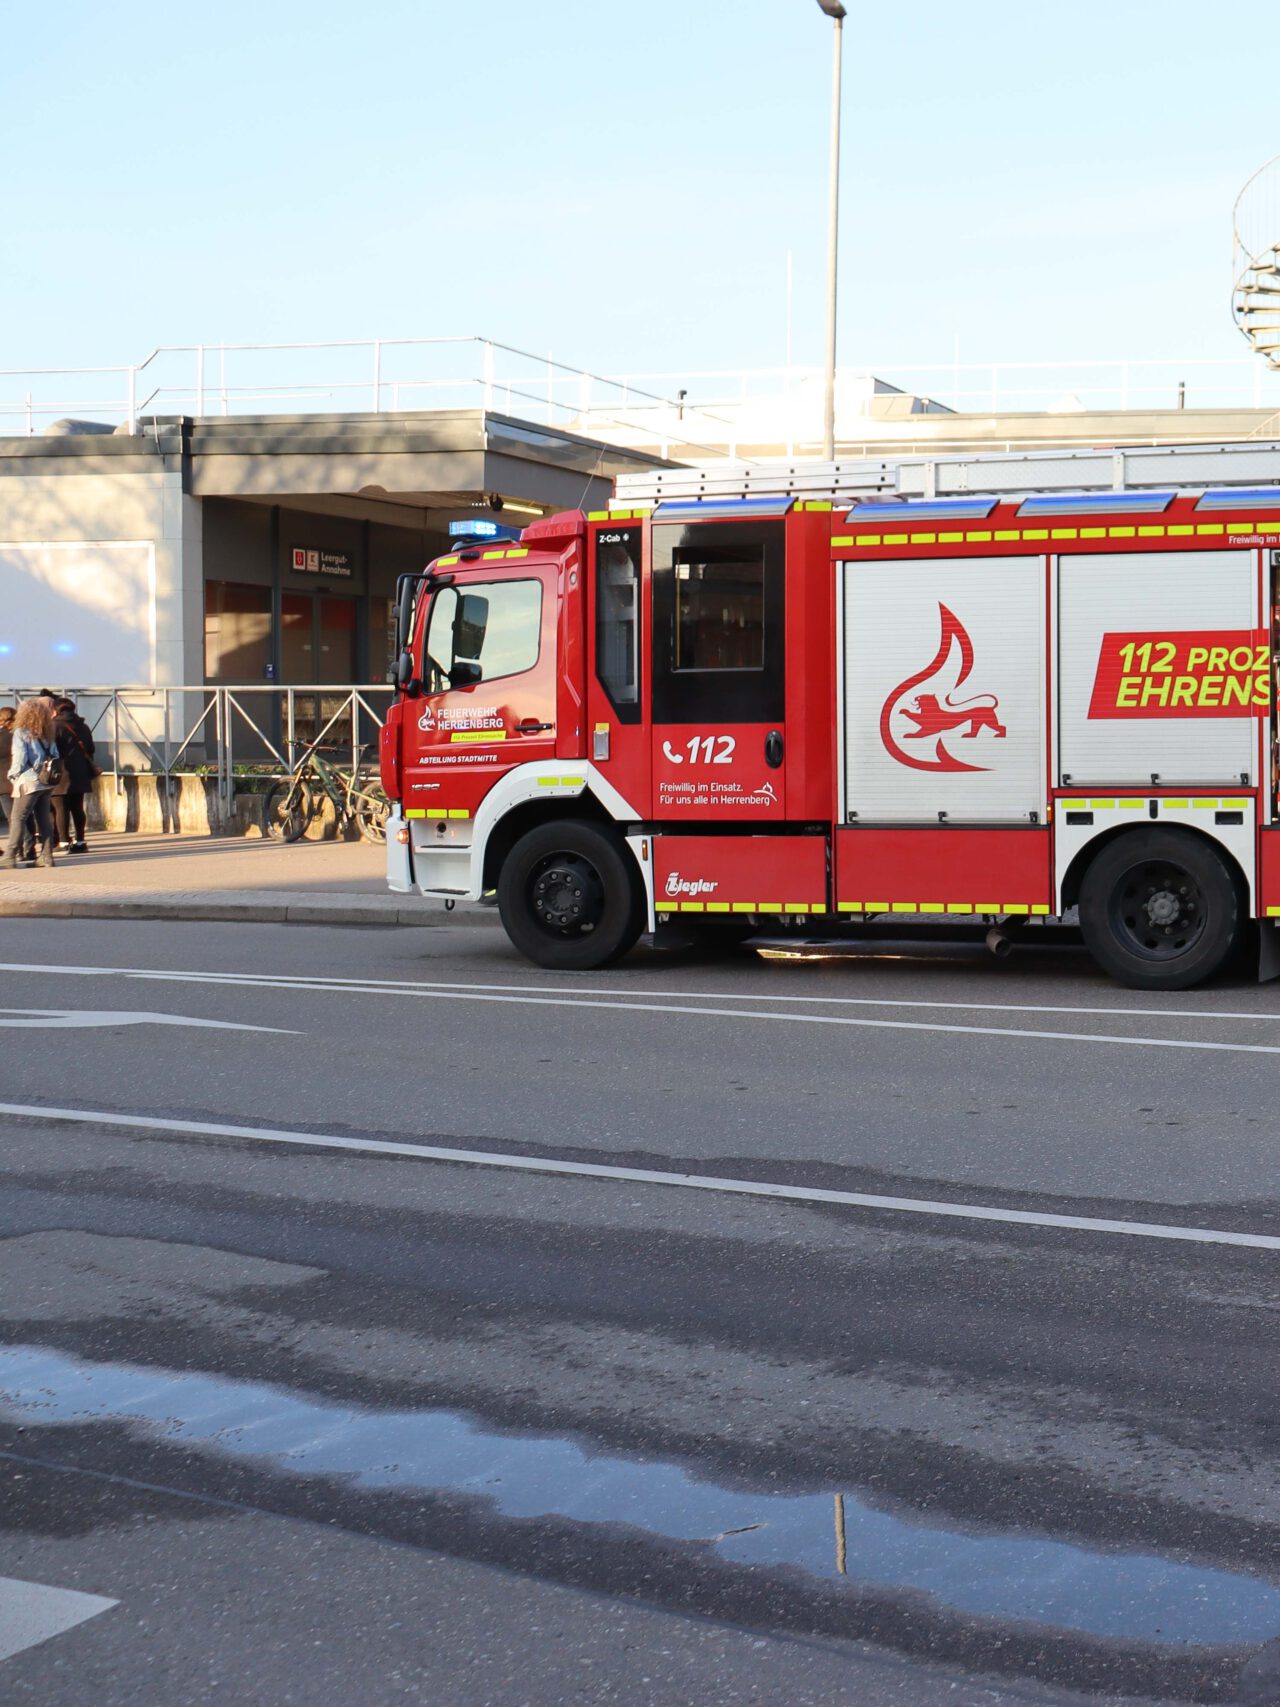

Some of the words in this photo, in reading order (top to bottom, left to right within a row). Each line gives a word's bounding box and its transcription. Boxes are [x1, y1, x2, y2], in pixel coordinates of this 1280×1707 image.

[599, 534, 621, 543] Z-Cab
[1228, 535, 1265, 545] Freiwillig
[1266, 535, 1277, 543] im
[1119, 641, 1177, 673] 112
[437, 706, 497, 719] FEUERWEHR
[437, 718, 504, 730] HERRENBERG
[686, 735, 736, 764] 112
[419, 756, 457, 764] ABTEILUNG
[457, 755, 498, 763] STADTMITTE
[659, 782, 696, 793] Freiwillig
[697, 782, 708, 792] im
[710, 782, 744, 792] Einsatz.
[659, 794, 674, 804] Für
[676, 796, 692, 804] uns
[693, 794, 709, 804] alle
[710, 794, 719, 804] in
[720, 794, 770, 806] Herrenberg
[665, 872, 719, 897] Ziegler
